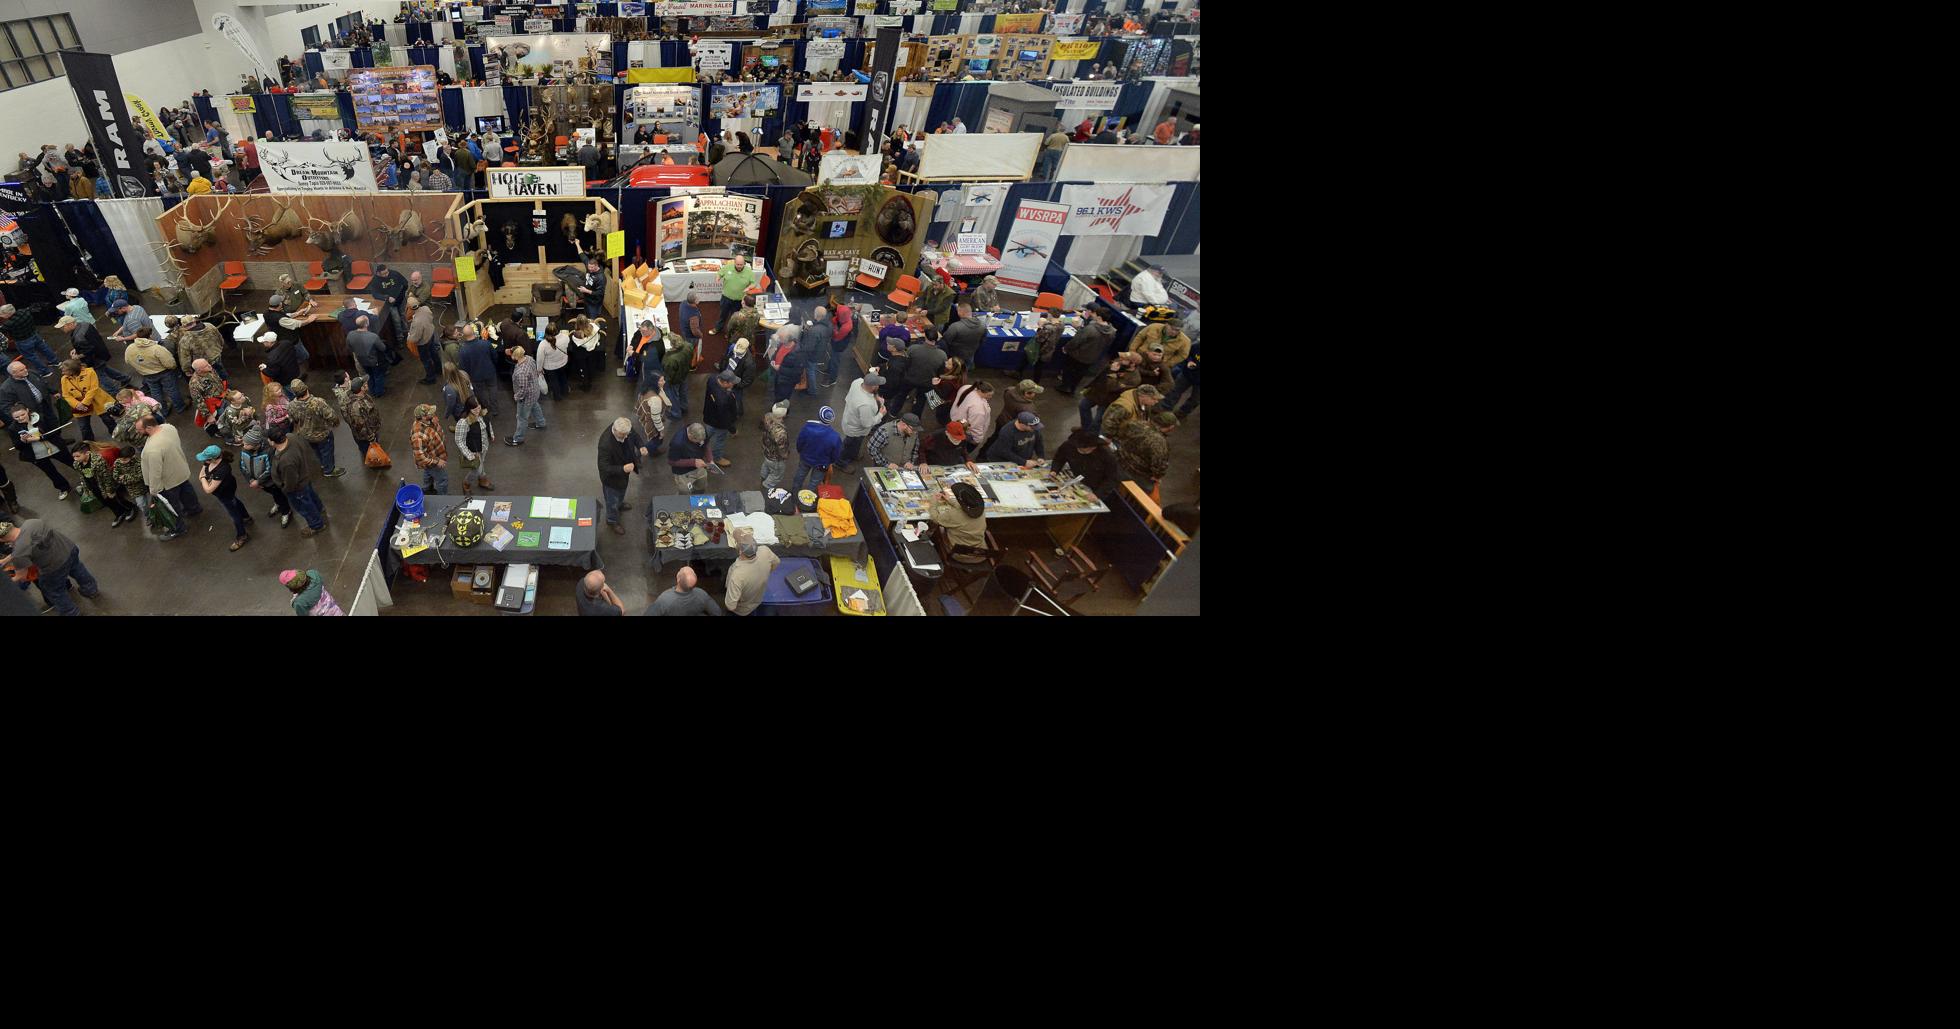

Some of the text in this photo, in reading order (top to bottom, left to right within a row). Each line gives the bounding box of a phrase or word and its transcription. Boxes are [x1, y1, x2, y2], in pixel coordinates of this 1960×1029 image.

[1053, 85, 1119, 98] INSULATED BUILDINGS
[93, 89, 131, 169] RAM
[866, 108, 879, 155] RA
[491, 172, 523, 185] HOG
[508, 183, 557, 195] HAVEN
[0, 192, 27, 202] ENTUCKY
[700, 199, 743, 208] APPALACHIAN
[1019, 207, 1064, 223] WVSRPA
[1075, 206, 1123, 215] 96.1 KWS
[867, 263, 885, 276] HUNT
